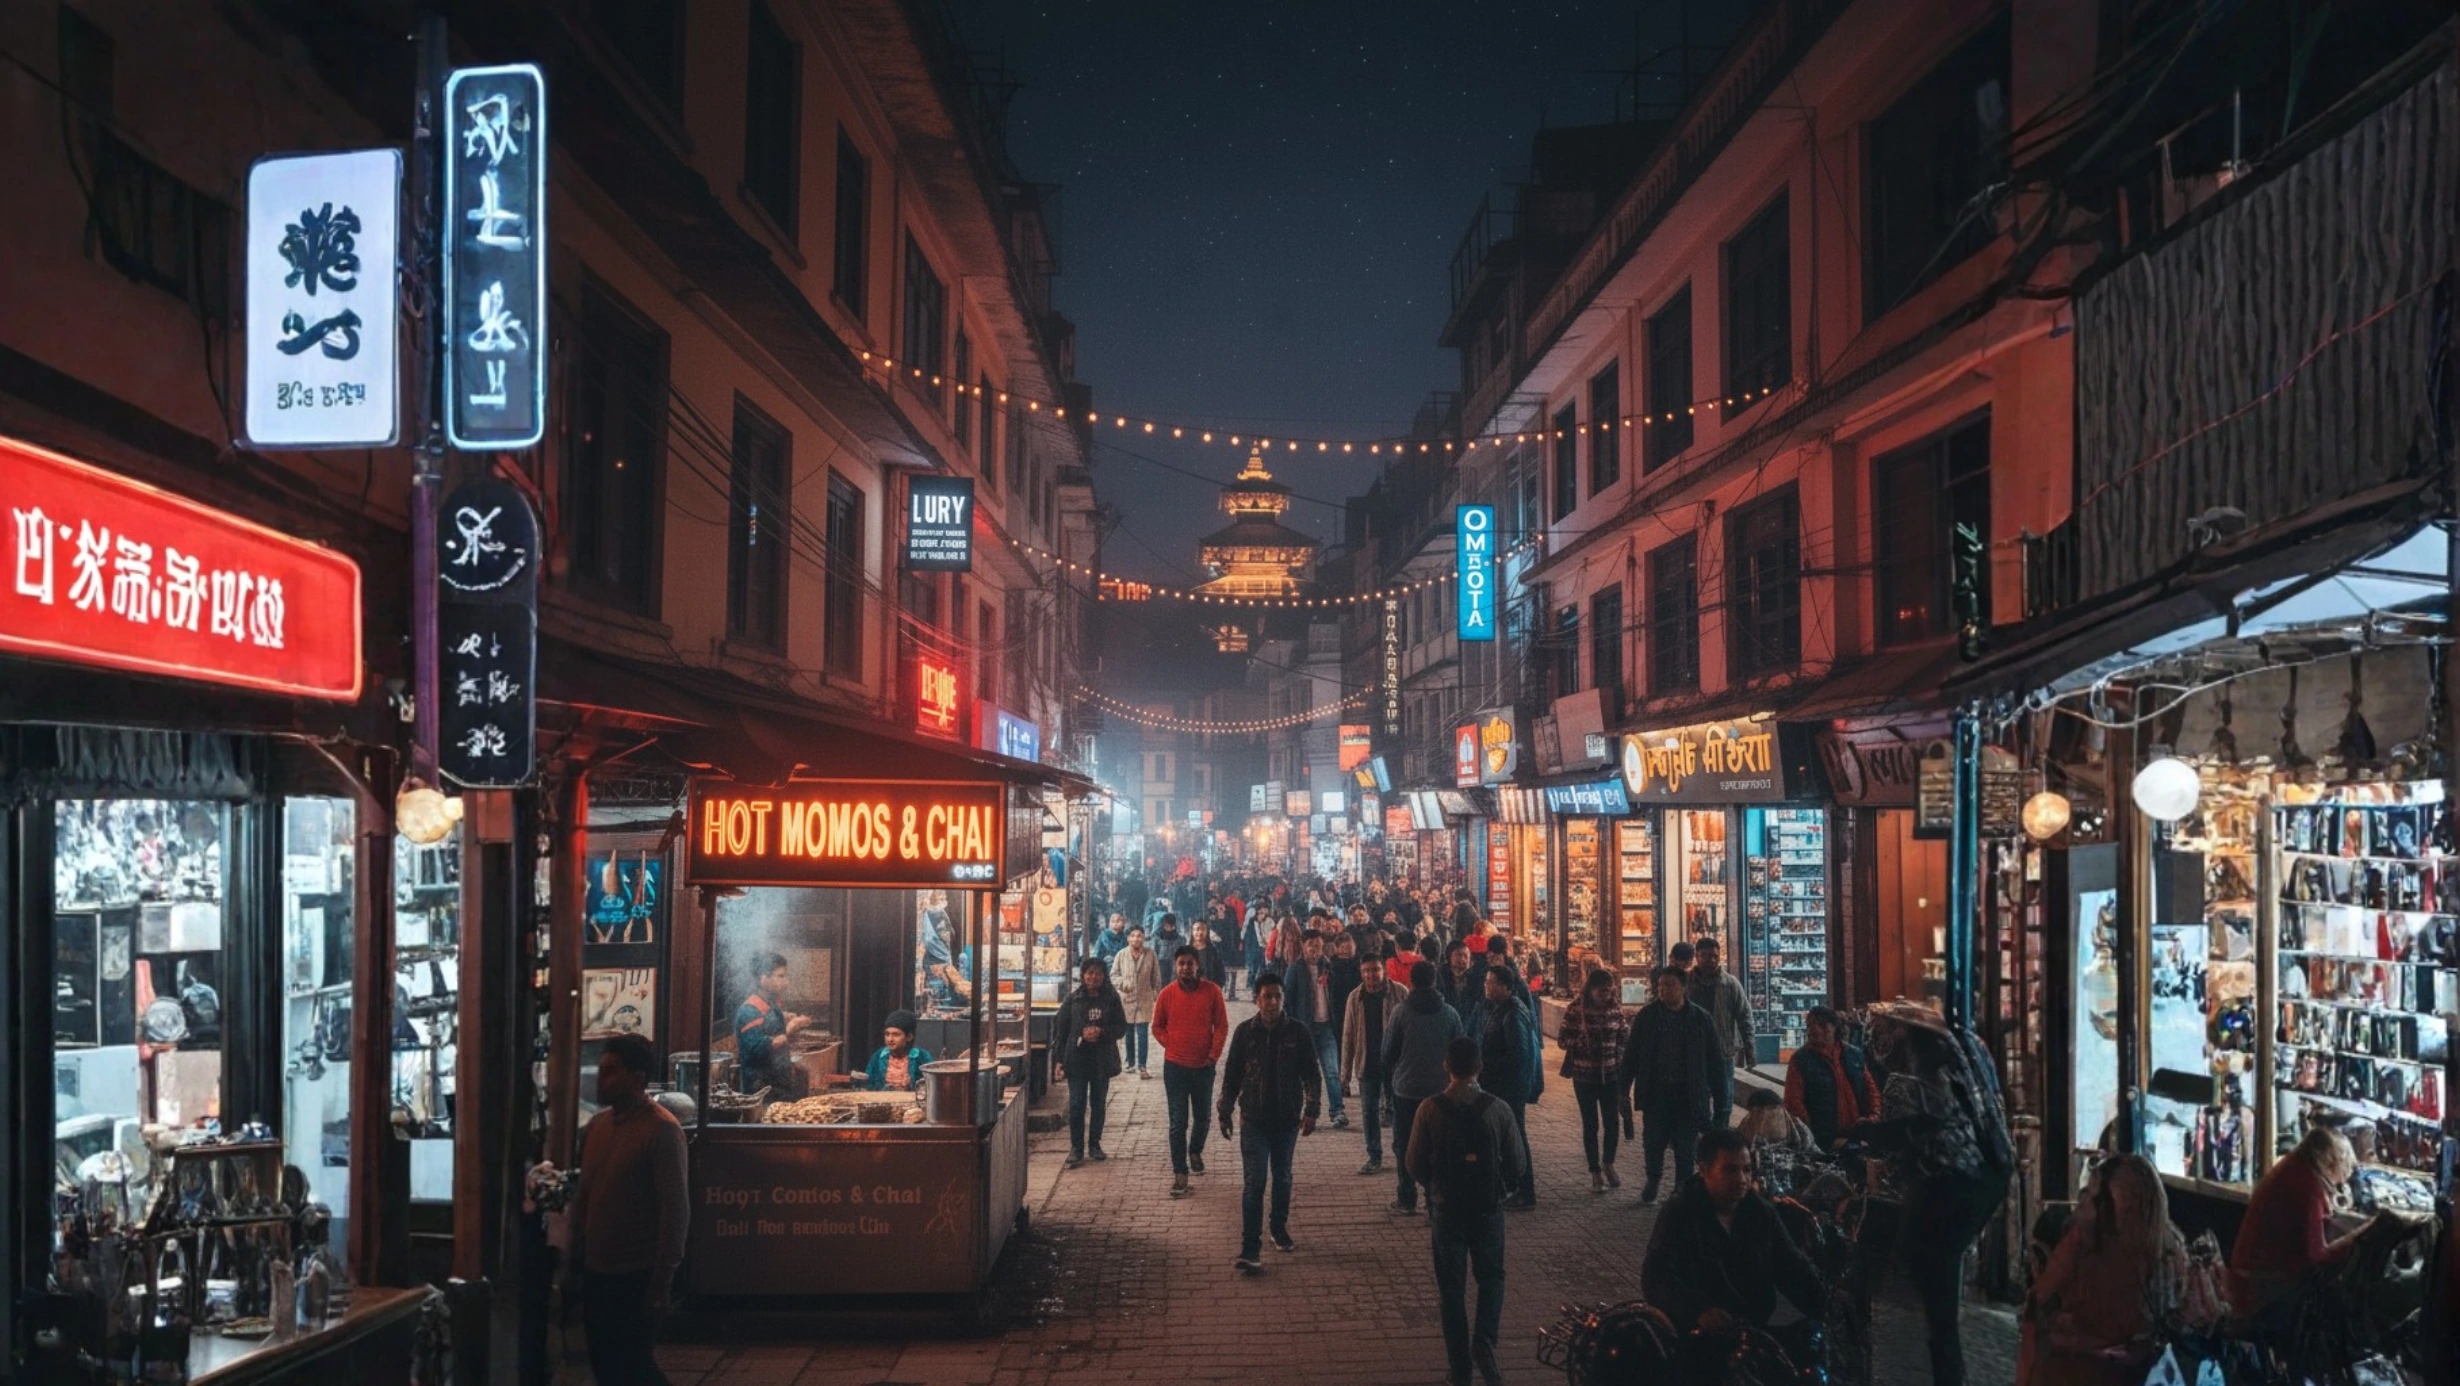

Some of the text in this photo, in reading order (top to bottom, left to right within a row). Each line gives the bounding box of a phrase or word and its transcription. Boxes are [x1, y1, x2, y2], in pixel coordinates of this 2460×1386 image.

[912, 494, 966, 525] LURY
[704, 800, 991, 860] HOT MOMOS & CHAI
